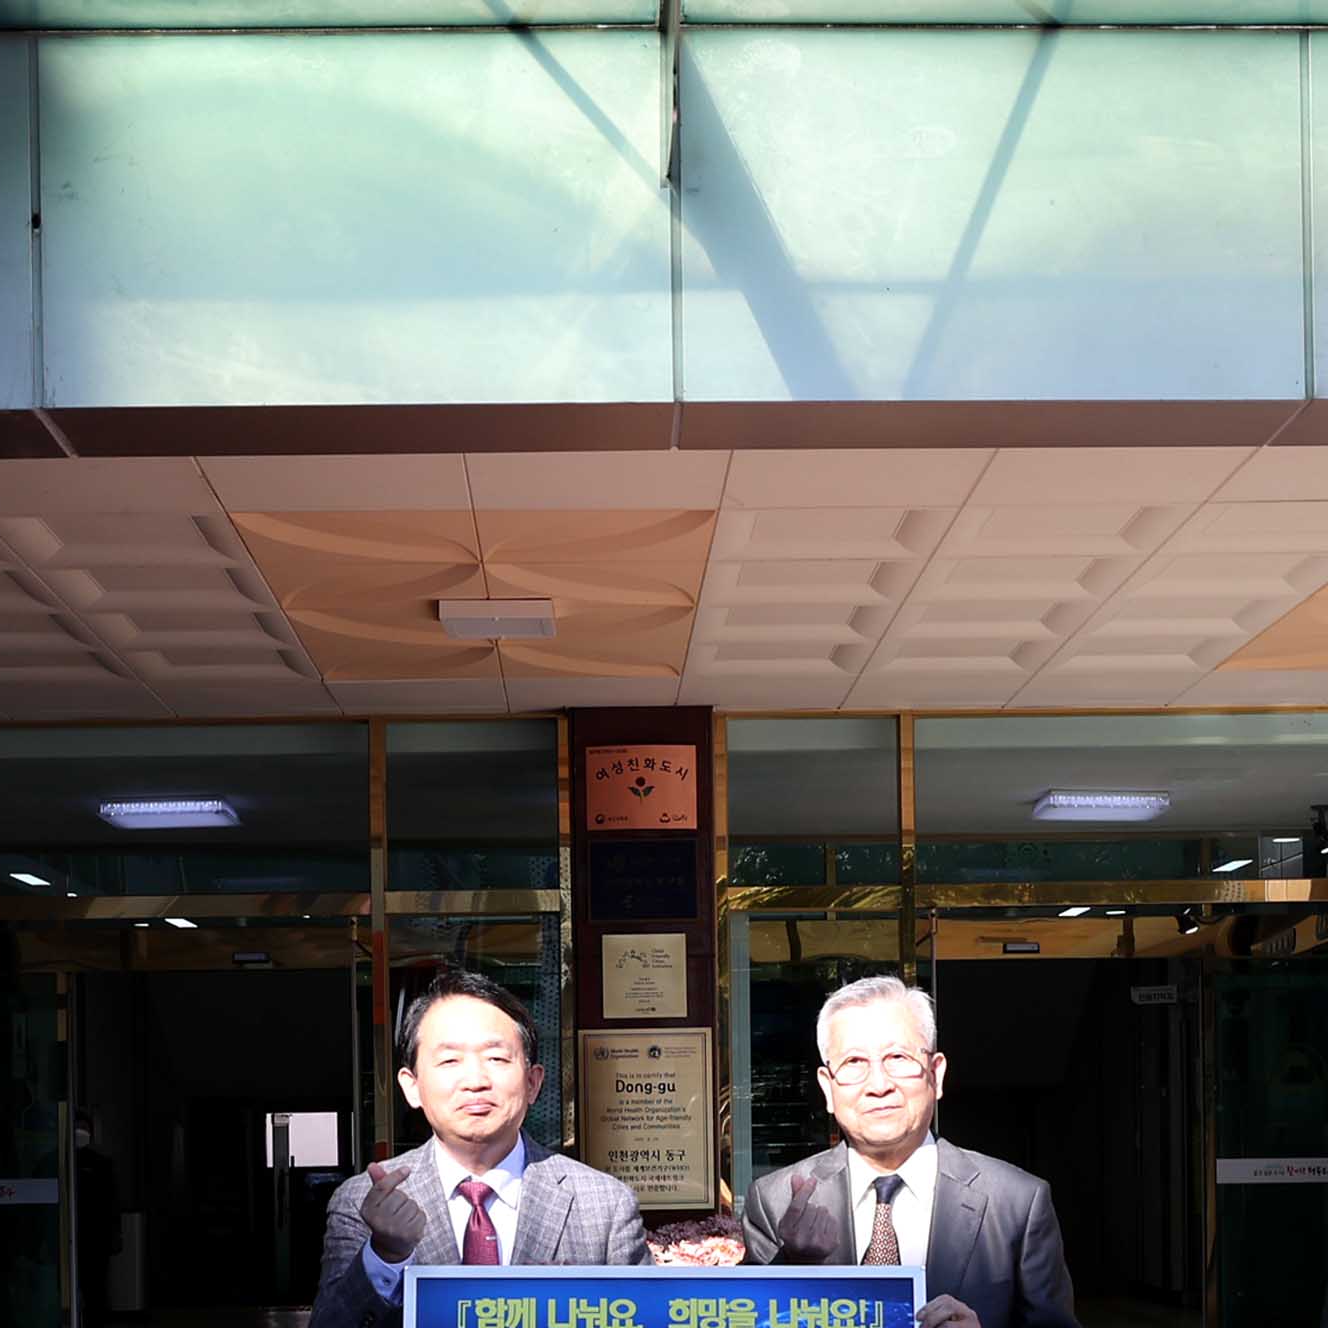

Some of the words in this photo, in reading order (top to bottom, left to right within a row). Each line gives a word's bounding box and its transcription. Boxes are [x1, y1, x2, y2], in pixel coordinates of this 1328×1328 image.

[615, 1079, 676, 1095] Dong-gu
[608, 1149, 661, 1163] 인천광역시
[665, 1149, 686, 1162] 동구
